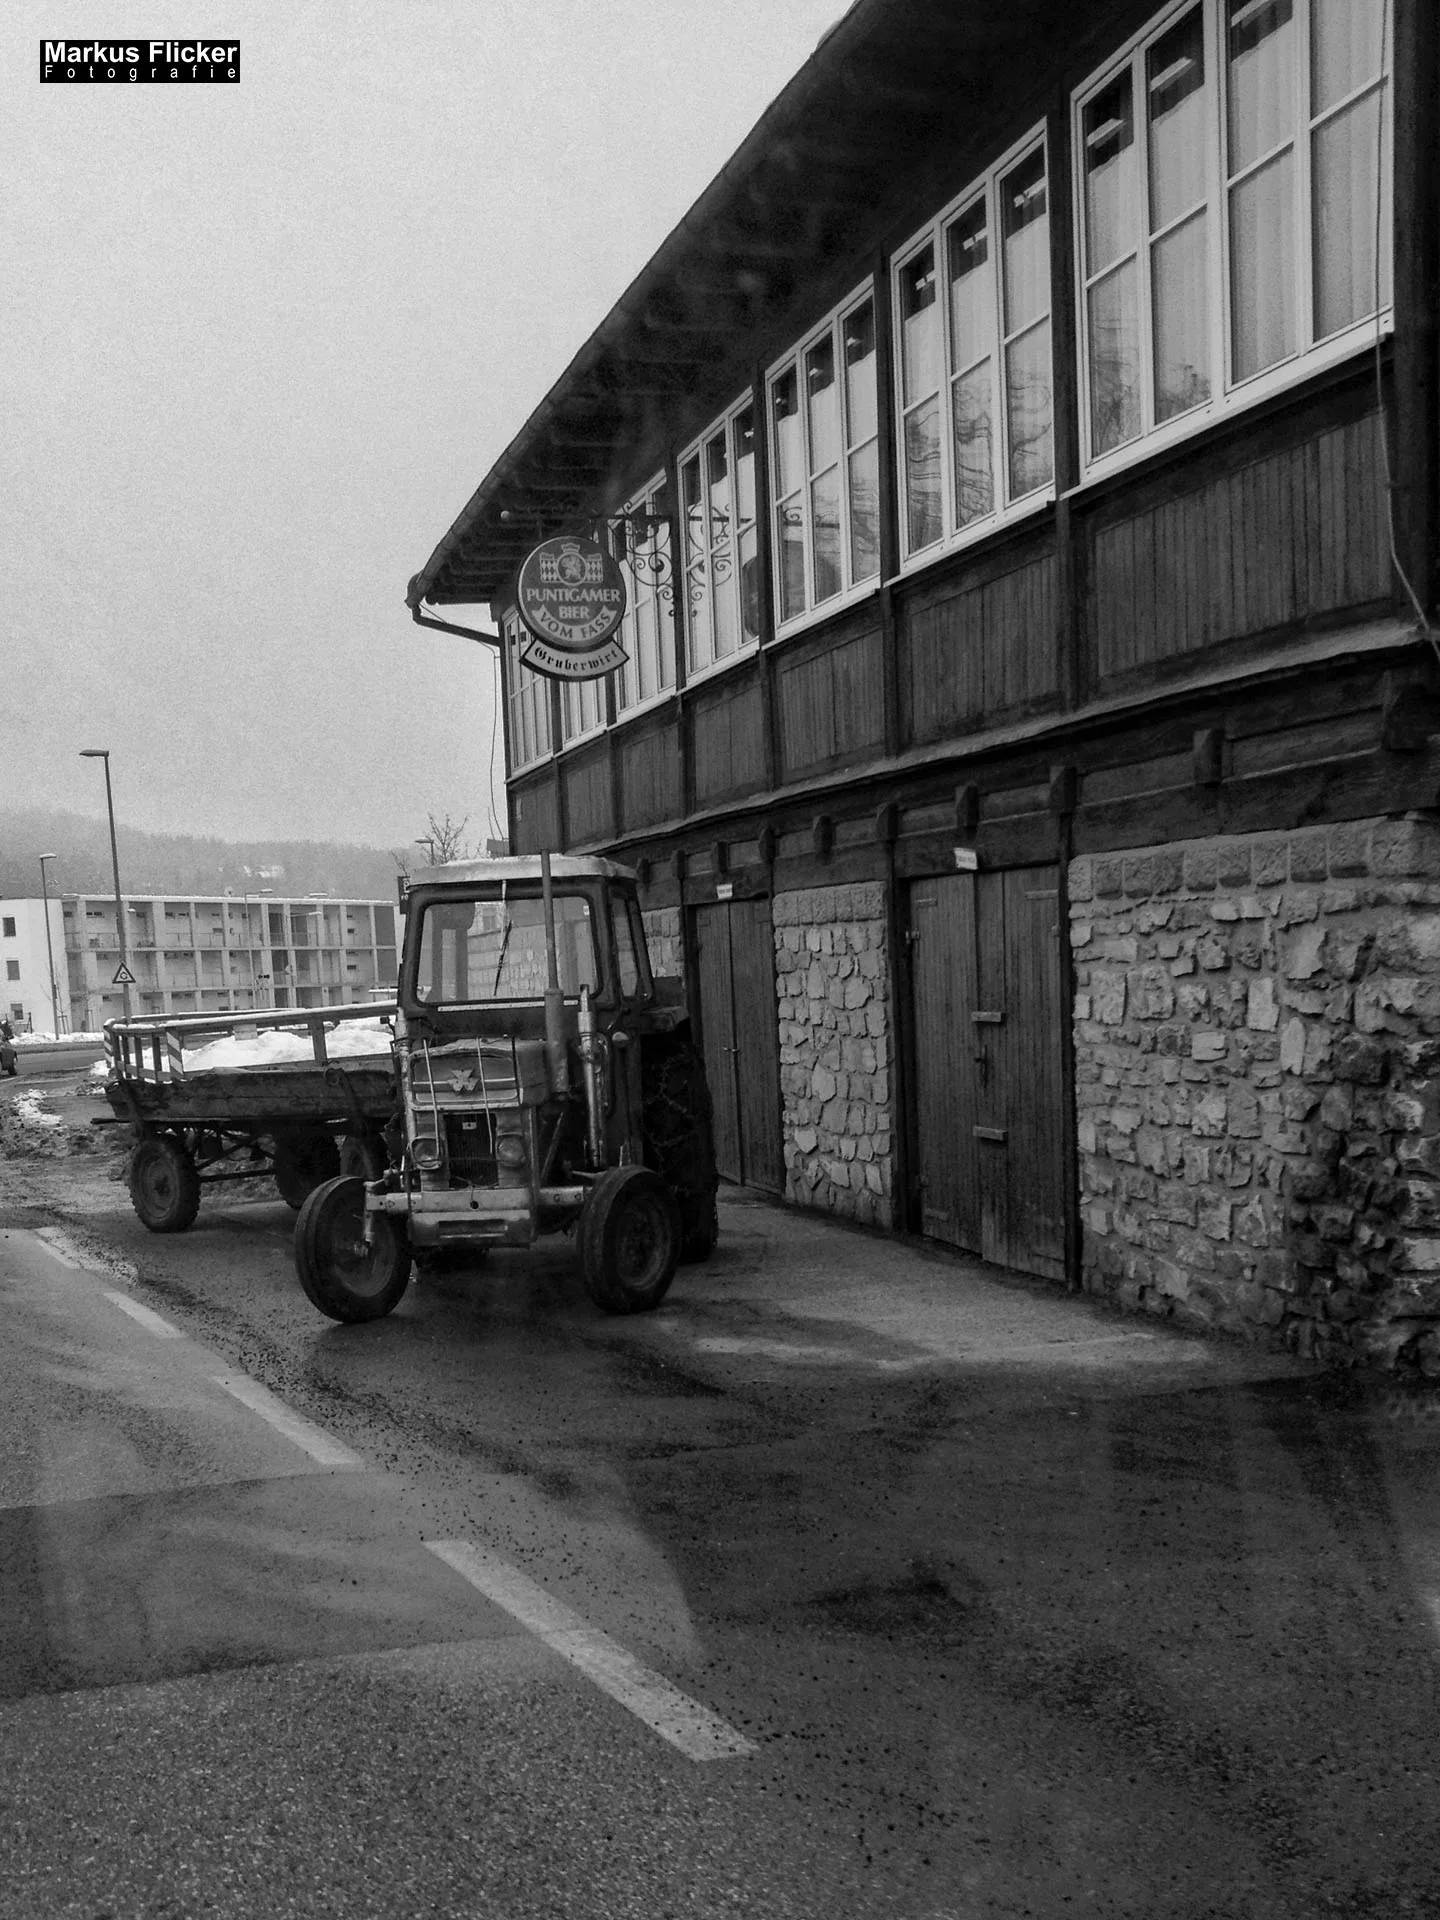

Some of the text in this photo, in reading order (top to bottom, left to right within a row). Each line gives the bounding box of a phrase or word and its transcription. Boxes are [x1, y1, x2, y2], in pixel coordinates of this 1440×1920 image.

[526, 588, 621, 602] PUNTIGAMER
[559, 606, 590, 619] BIER
[541, 612, 611, 638] VOM FASS
[534, 647, 618, 671] Gruberwirt
